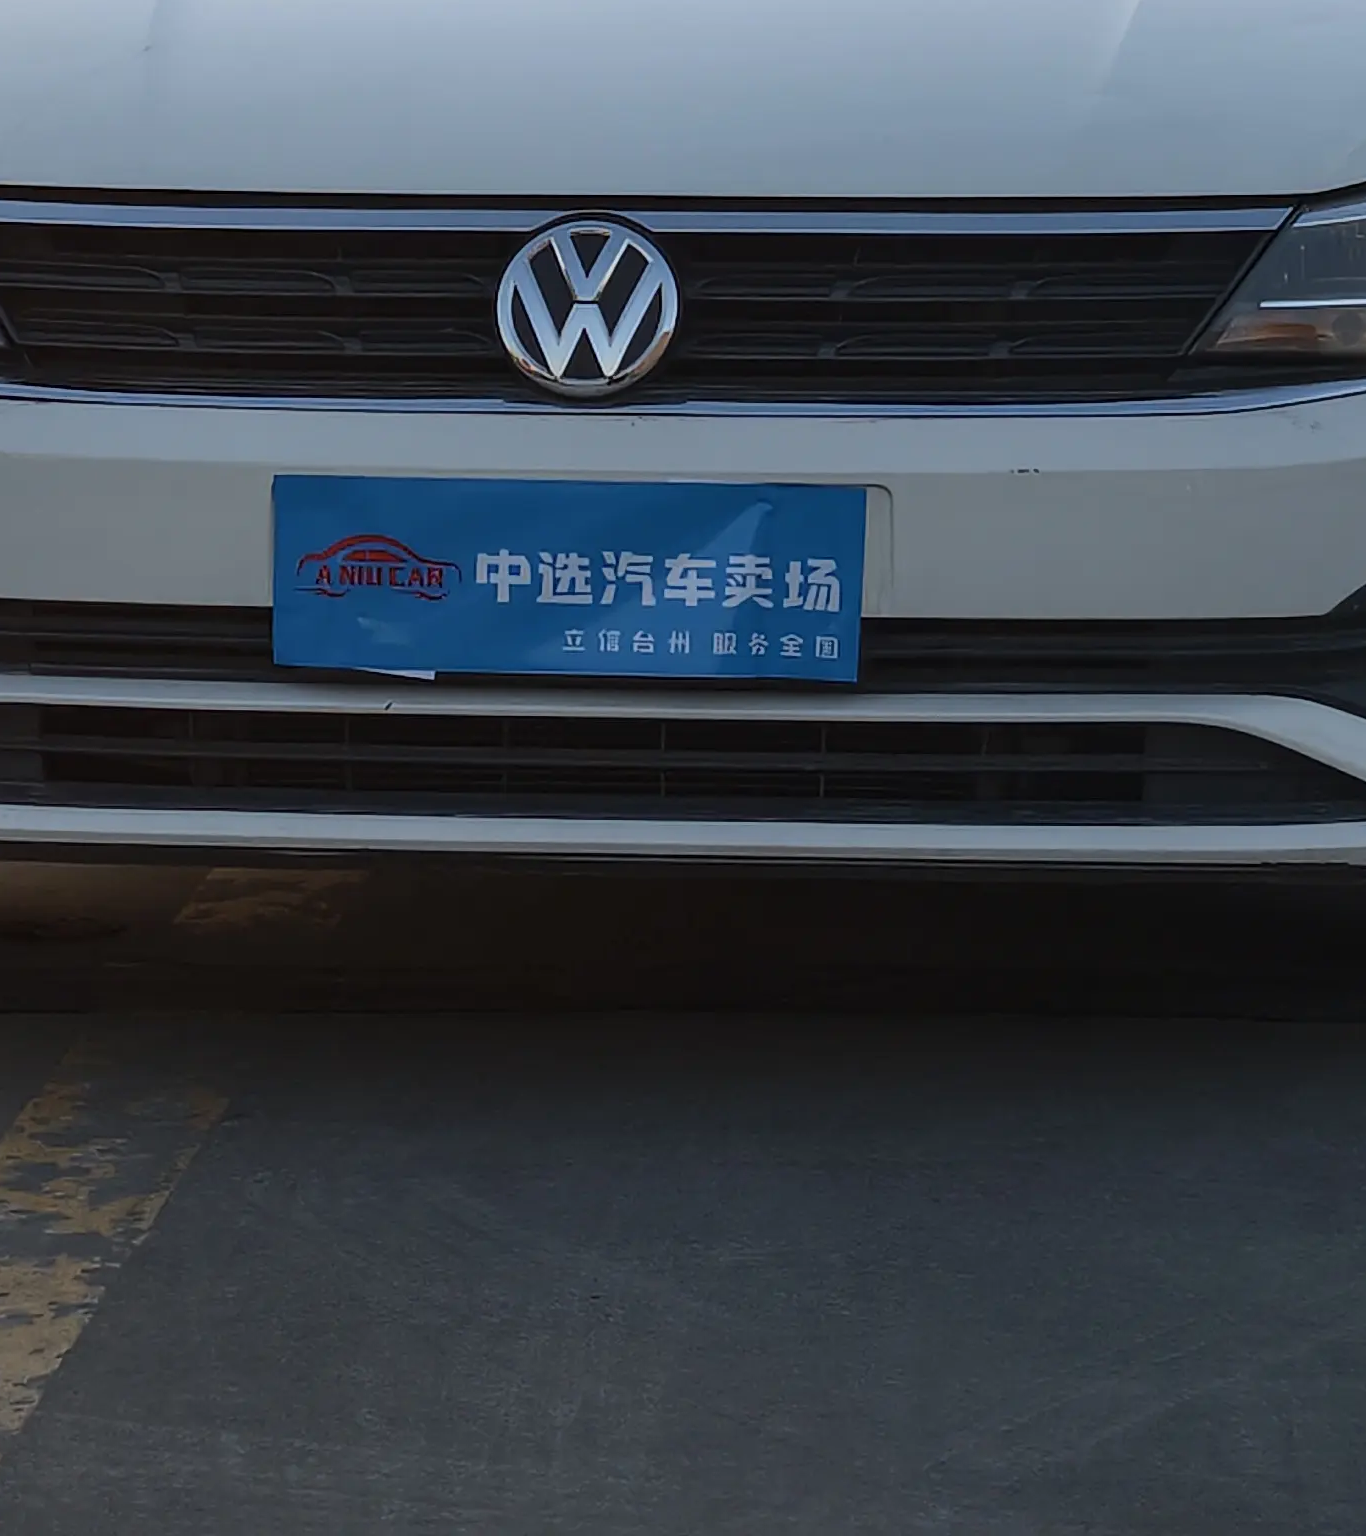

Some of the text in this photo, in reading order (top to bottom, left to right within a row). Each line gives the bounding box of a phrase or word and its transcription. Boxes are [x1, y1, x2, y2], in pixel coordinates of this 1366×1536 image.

[475, 549, 841, 612] 中选汽车卖场
